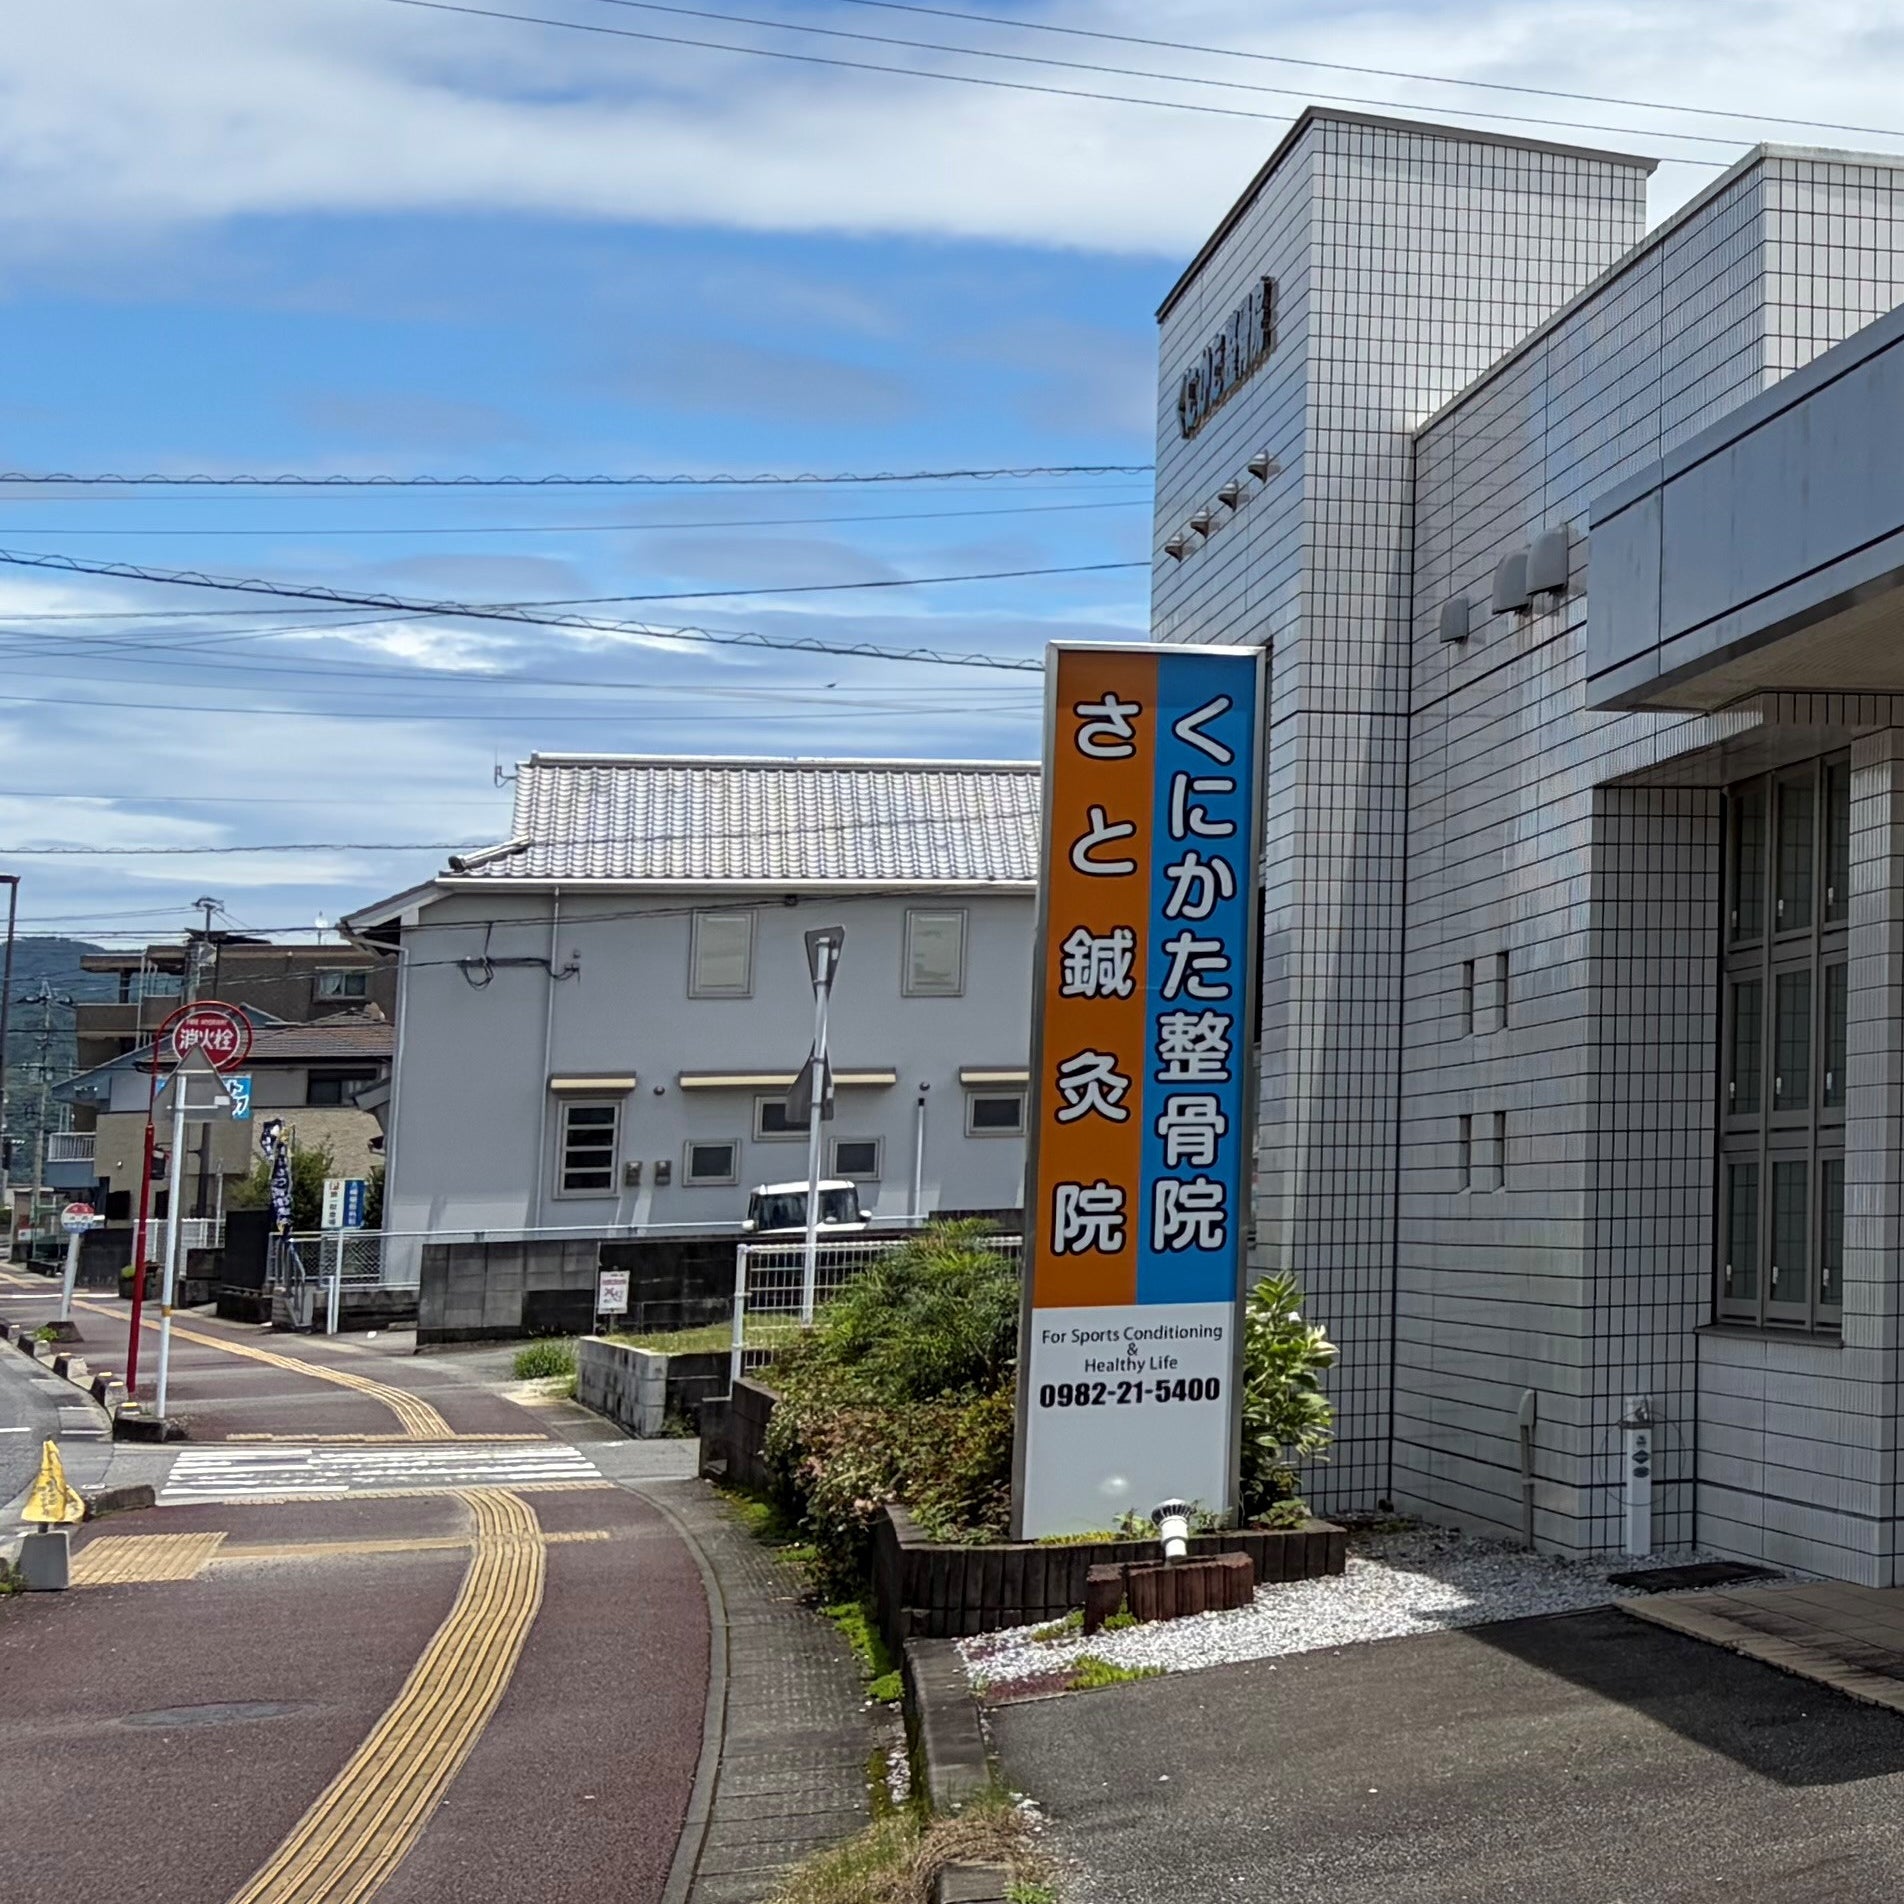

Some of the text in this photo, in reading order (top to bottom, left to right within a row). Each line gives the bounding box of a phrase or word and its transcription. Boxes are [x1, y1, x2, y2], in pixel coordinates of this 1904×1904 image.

[1052, 690, 1144, 1257] さと鍼灸院
[1151, 693, 1238, 1255] くにかた整骨院
[179, 1028, 234, 1050] 消火栓
[1041, 1323, 1224, 1346] For Sports Conditioning
[1126, 1342, 1139, 1356] &
[1084, 1354, 1179, 1374] Healthy Life
[1039, 1376, 1221, 1409] 0982-21-5400
